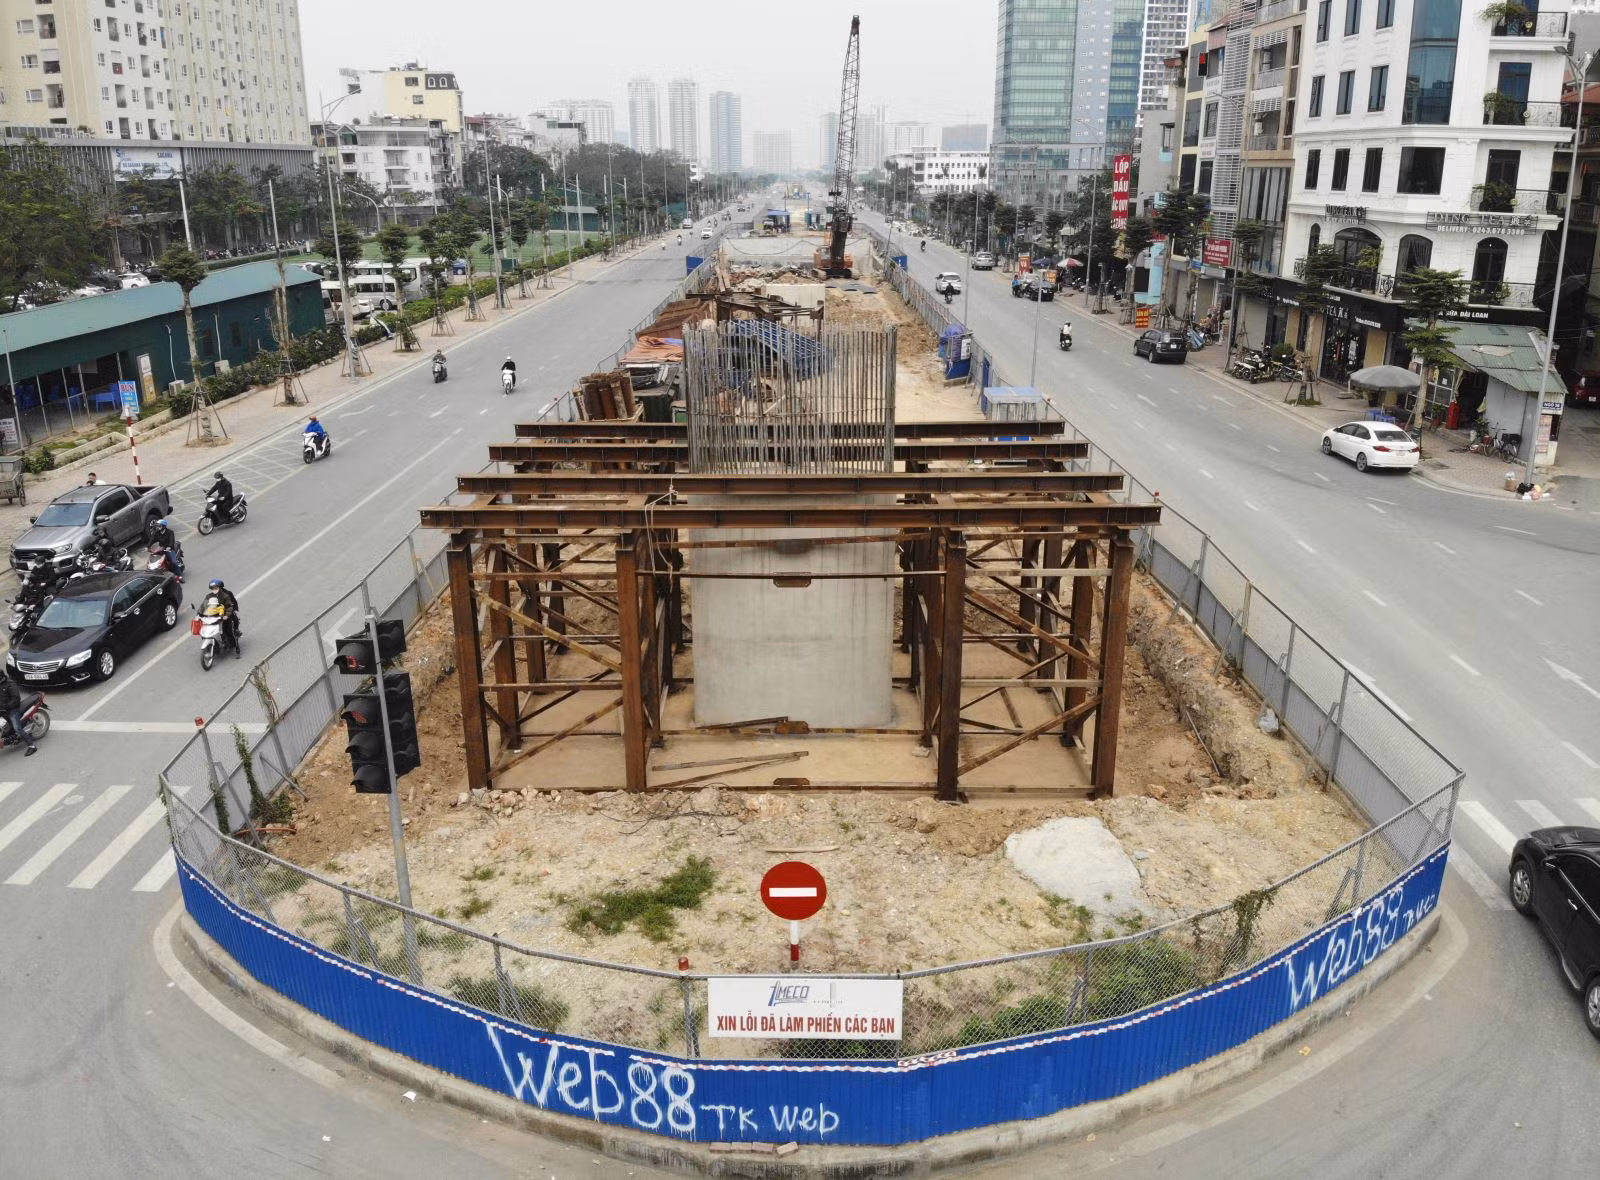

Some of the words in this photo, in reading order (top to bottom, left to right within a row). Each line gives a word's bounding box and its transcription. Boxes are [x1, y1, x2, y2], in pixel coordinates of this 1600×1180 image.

[1434, 212, 1470, 223] DING
[1480, 214, 1505, 225] TEA
[717, 1015, 737, 1031] XIN
[740, 1010, 757, 1031] LỖI
[761, 1013, 776, 1032] ĐÃ
[780, 1013, 803, 1032] LÀM
[845, 1013, 868, 1033] CÁC
[871, 1017, 895, 1037] BẠN
